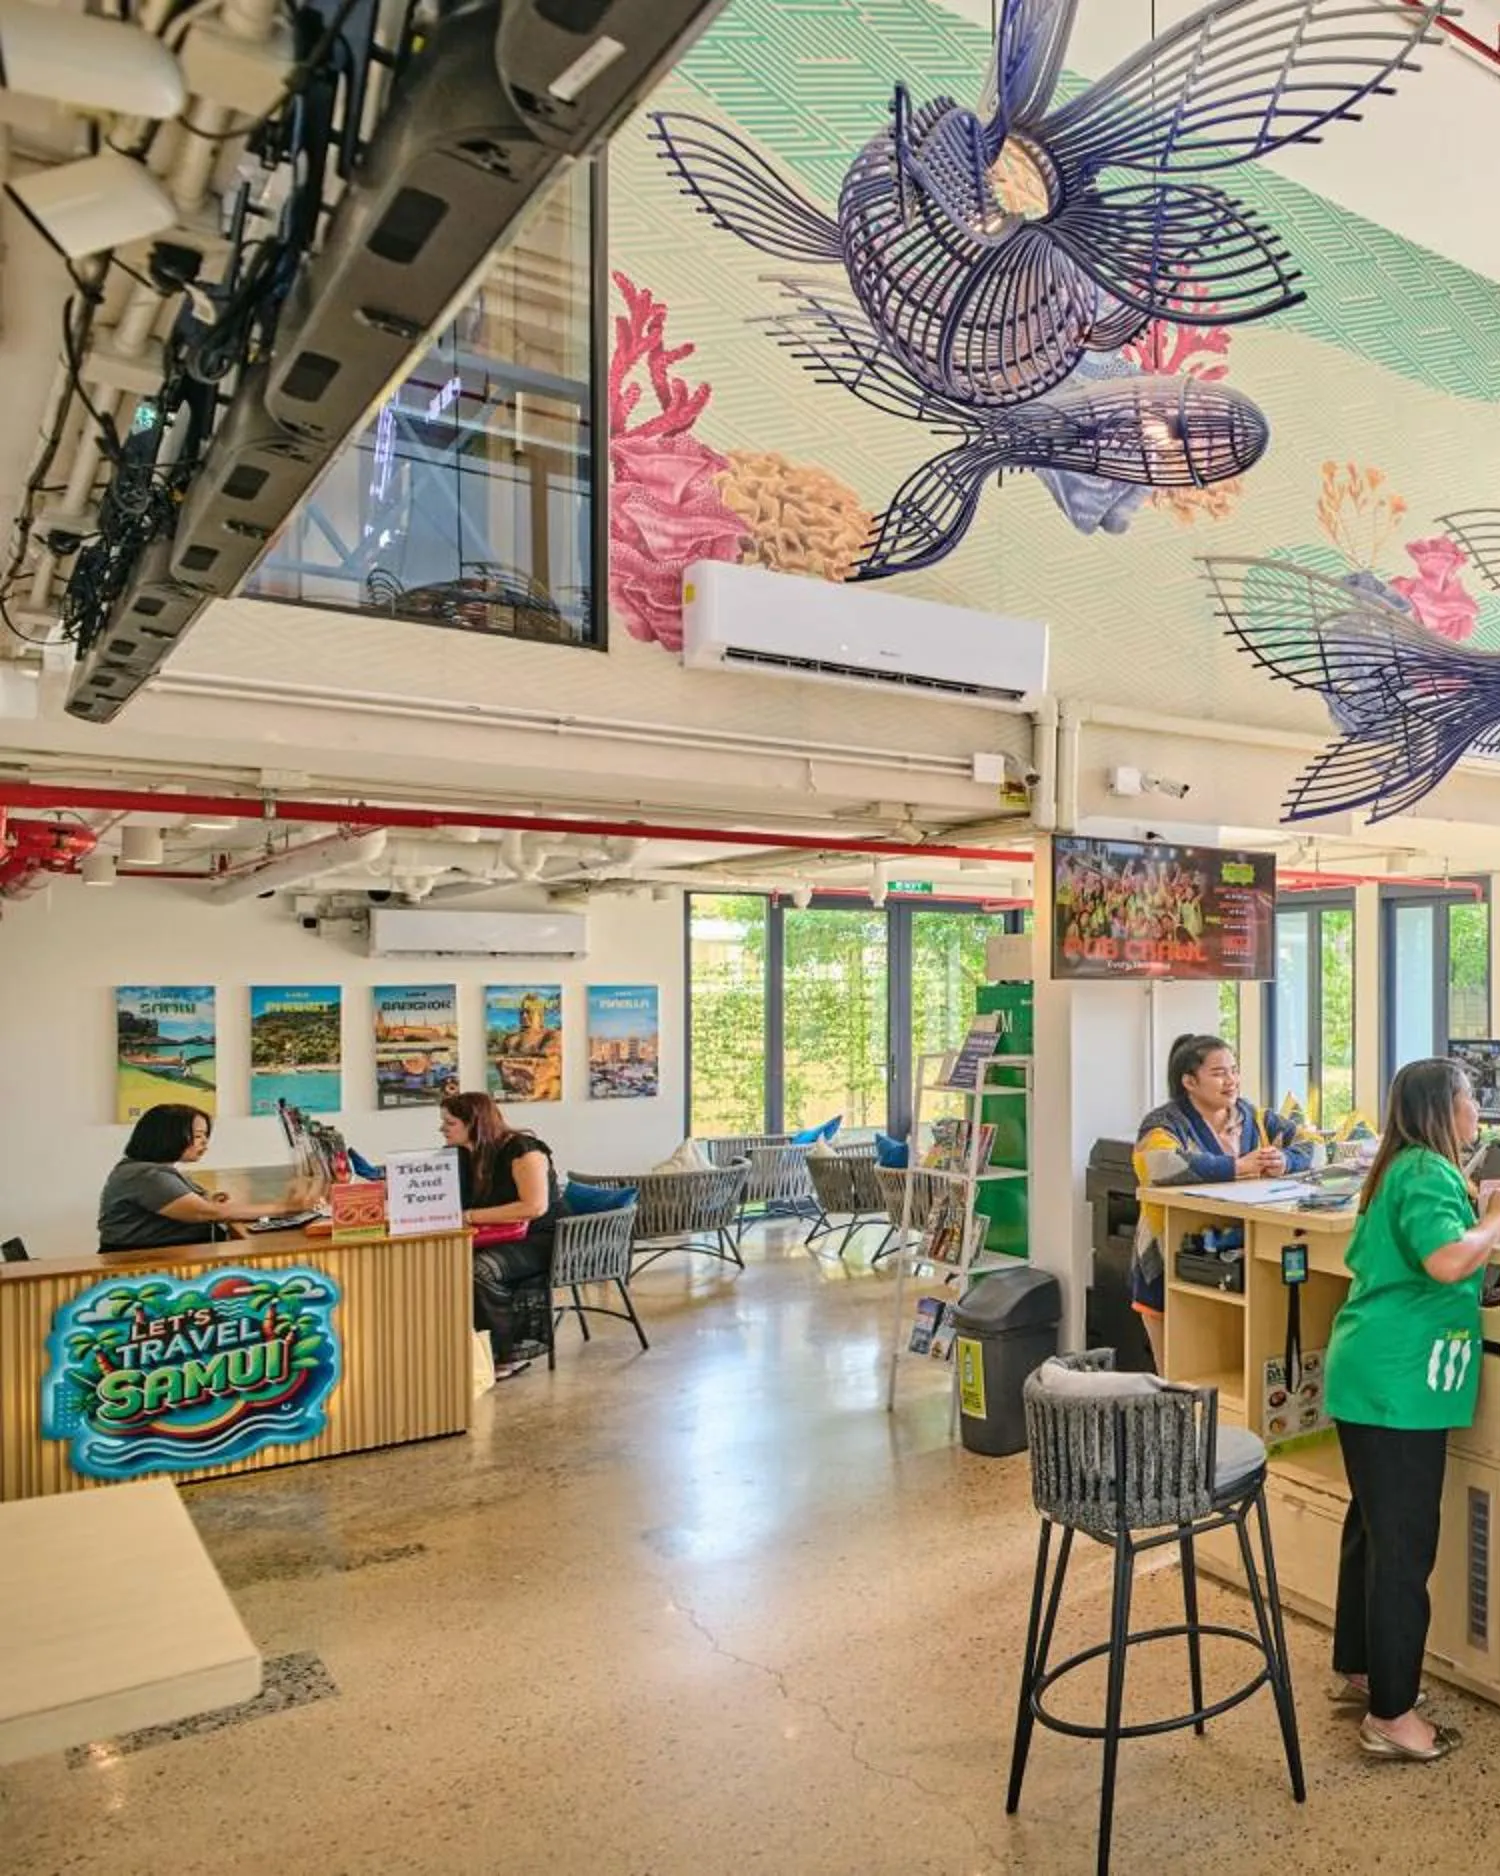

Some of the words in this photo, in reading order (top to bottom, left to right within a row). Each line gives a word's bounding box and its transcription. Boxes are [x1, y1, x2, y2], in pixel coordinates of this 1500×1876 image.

[396, 1163, 452, 1175] Ticket
[408, 1178, 443, 1189] And
[403, 1192, 447, 1204] Tour
[131, 1307, 214, 1342] LET'S
[116, 1316, 261, 1370] TRAVEL
[97, 1339, 289, 1420] SAMUI
